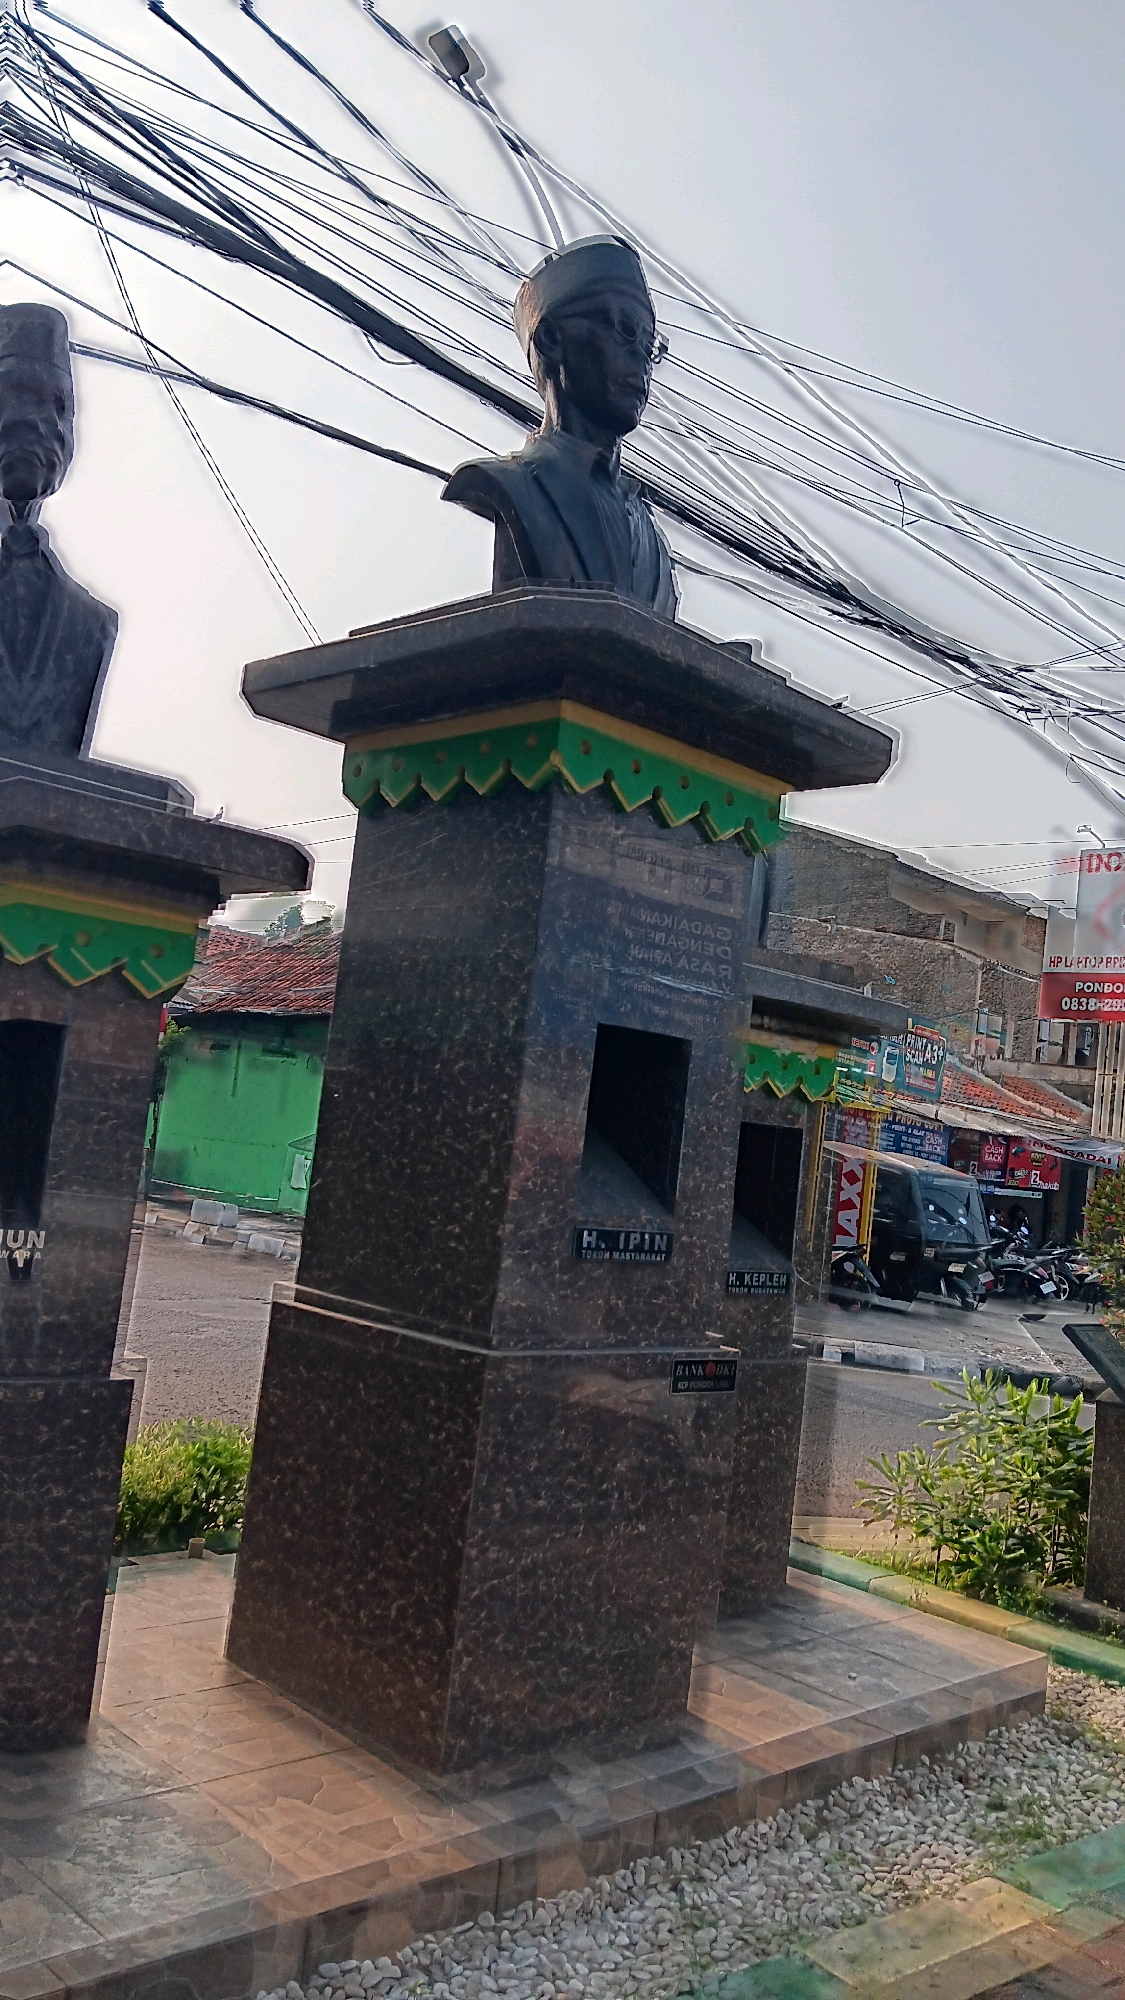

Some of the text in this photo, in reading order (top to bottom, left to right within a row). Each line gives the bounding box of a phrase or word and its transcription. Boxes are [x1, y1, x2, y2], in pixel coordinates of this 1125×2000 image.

[1049, 955, 1062, 968] HP
[1075, 981, 1125, 994] PONDO
[905, 1033, 928, 1051] PRINT
[905, 1049, 924, 1065] SCAN
[985, 1144, 1004, 1155] CASH
[984, 1153, 1003, 1163] BACK
[835, 1156, 864, 1247] AXX
[619, 1232, 668, 1251] IPIN
[582, 1249, 667, 1261] TOKOH MASYARAKAT
[728, 1272, 787, 1287] H. KEPLEH
[716, 1363, 735, 1376] DKI
